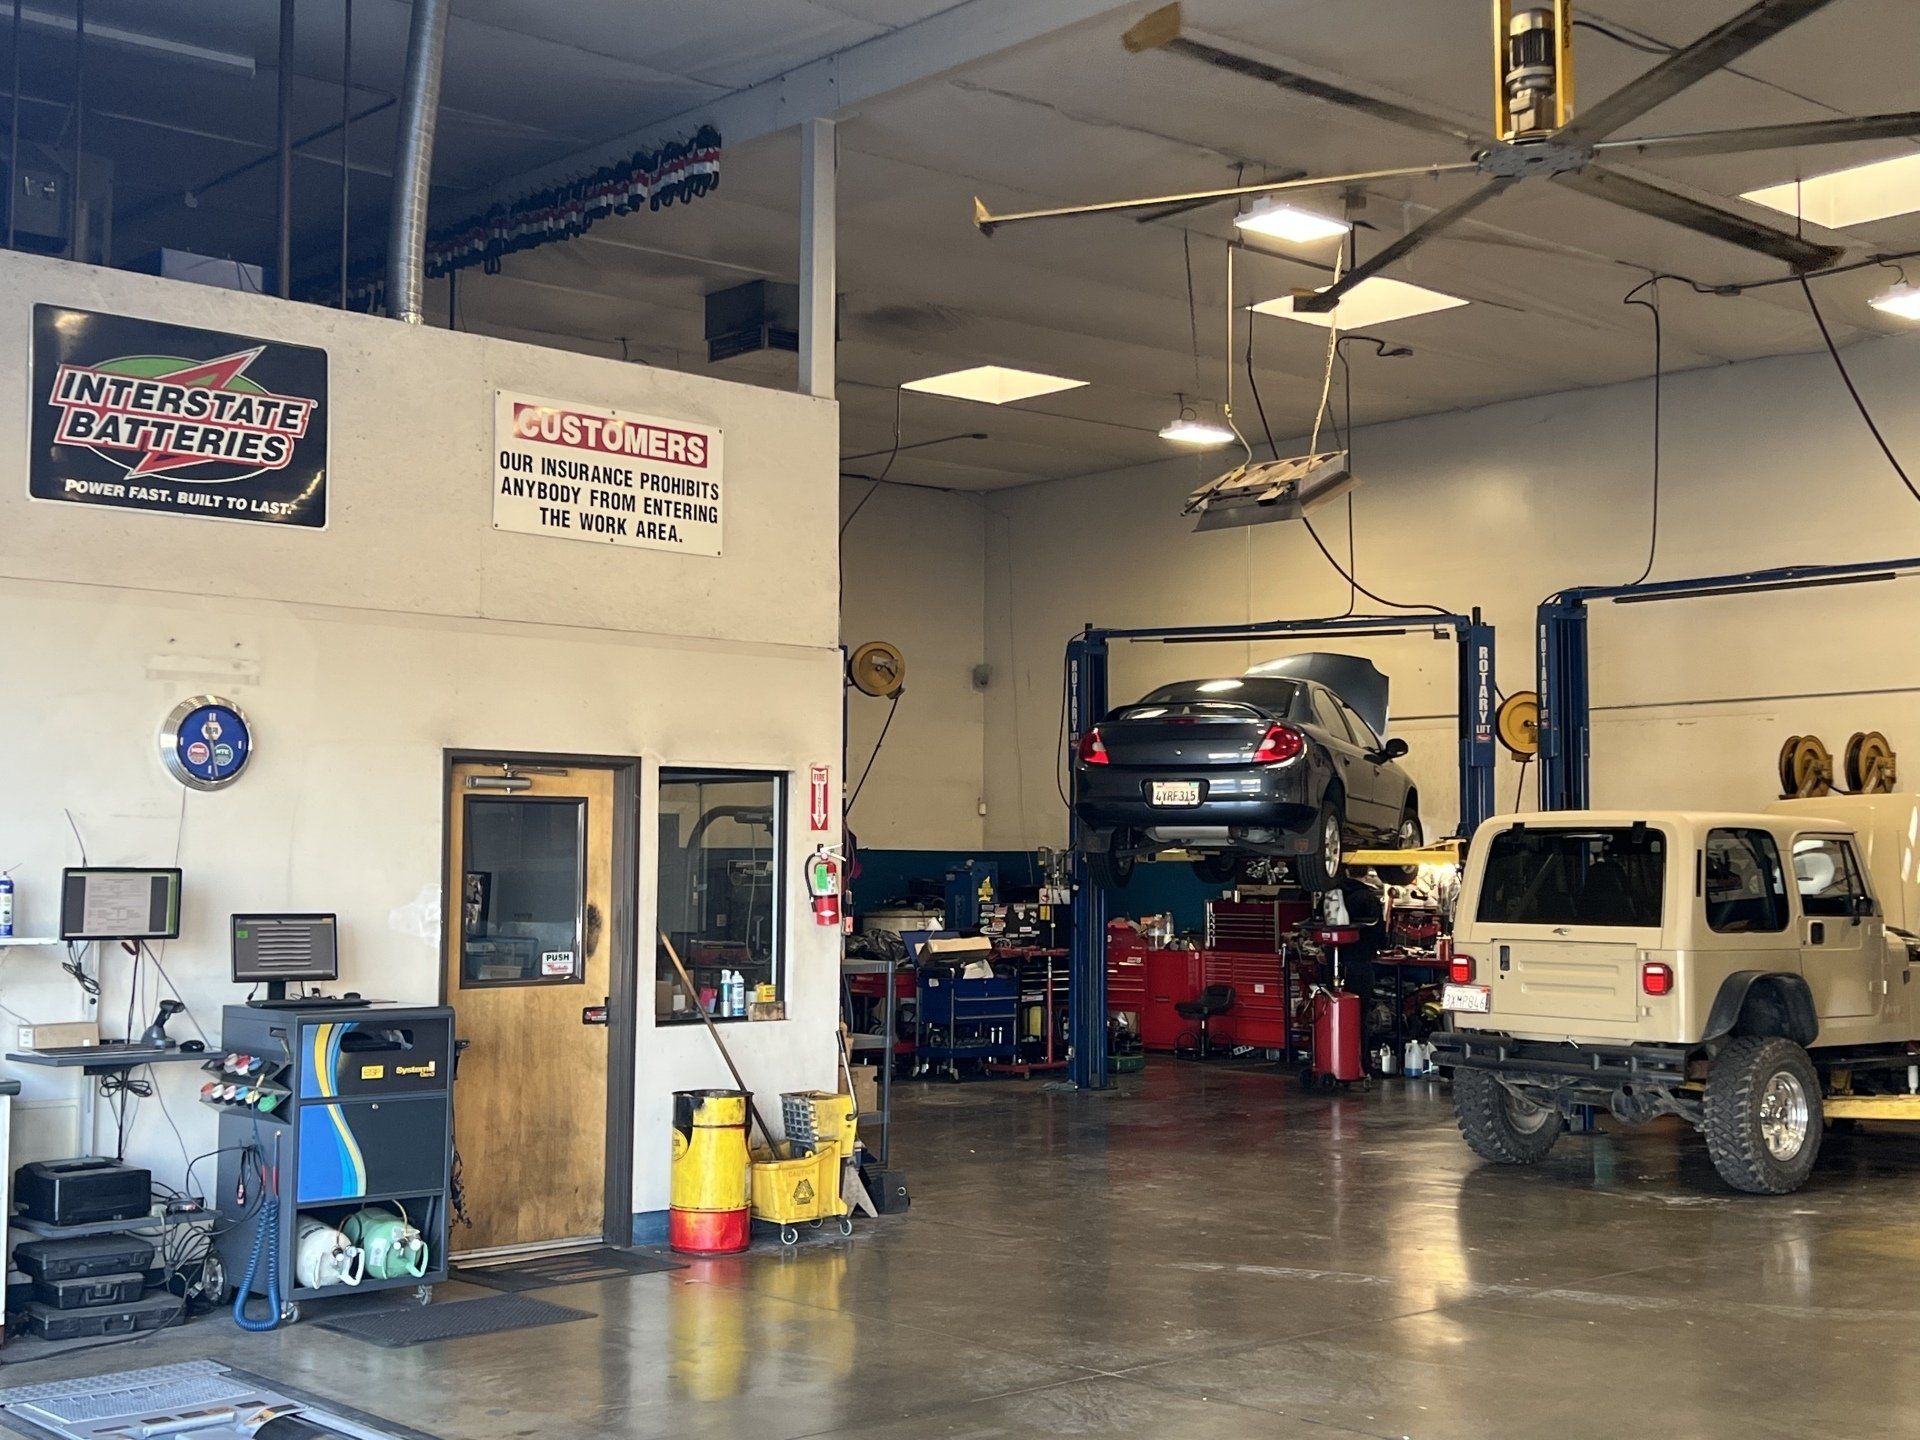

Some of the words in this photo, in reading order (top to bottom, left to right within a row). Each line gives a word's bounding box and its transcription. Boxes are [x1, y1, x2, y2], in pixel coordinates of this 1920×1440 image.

[58, 369, 307, 433] INTERSTATE
[65, 411, 290, 466] BATTERIES
[517, 407, 706, 466] CUSTOMERS
[65, 478, 126, 499] POWER
[128, 484, 173, 503] FAST.
[177, 491, 223, 509] BUILT
[227, 496, 248, 511] TO
[500, 451, 533, 473] OUR
[541, 457, 633, 488] INSURANCE
[640, 472, 719, 501] PROHIBITS
[501, 476, 581, 504] ANYBODY
[590, 490, 636, 513] FROM
[643, 498, 718, 524] ENTERING
[539, 507, 571, 529] THE
[579, 512, 627, 536] WORK
[636, 521, 683, 543] AREA.
[1479, 646, 1488, 724] ROTARY
[1476, 724, 1491, 734] LIFT
[813, 773, 825, 782] FIRE
[546, 954, 569, 962] PUSH
[788, 1169, 815, 1178] CAUTION
